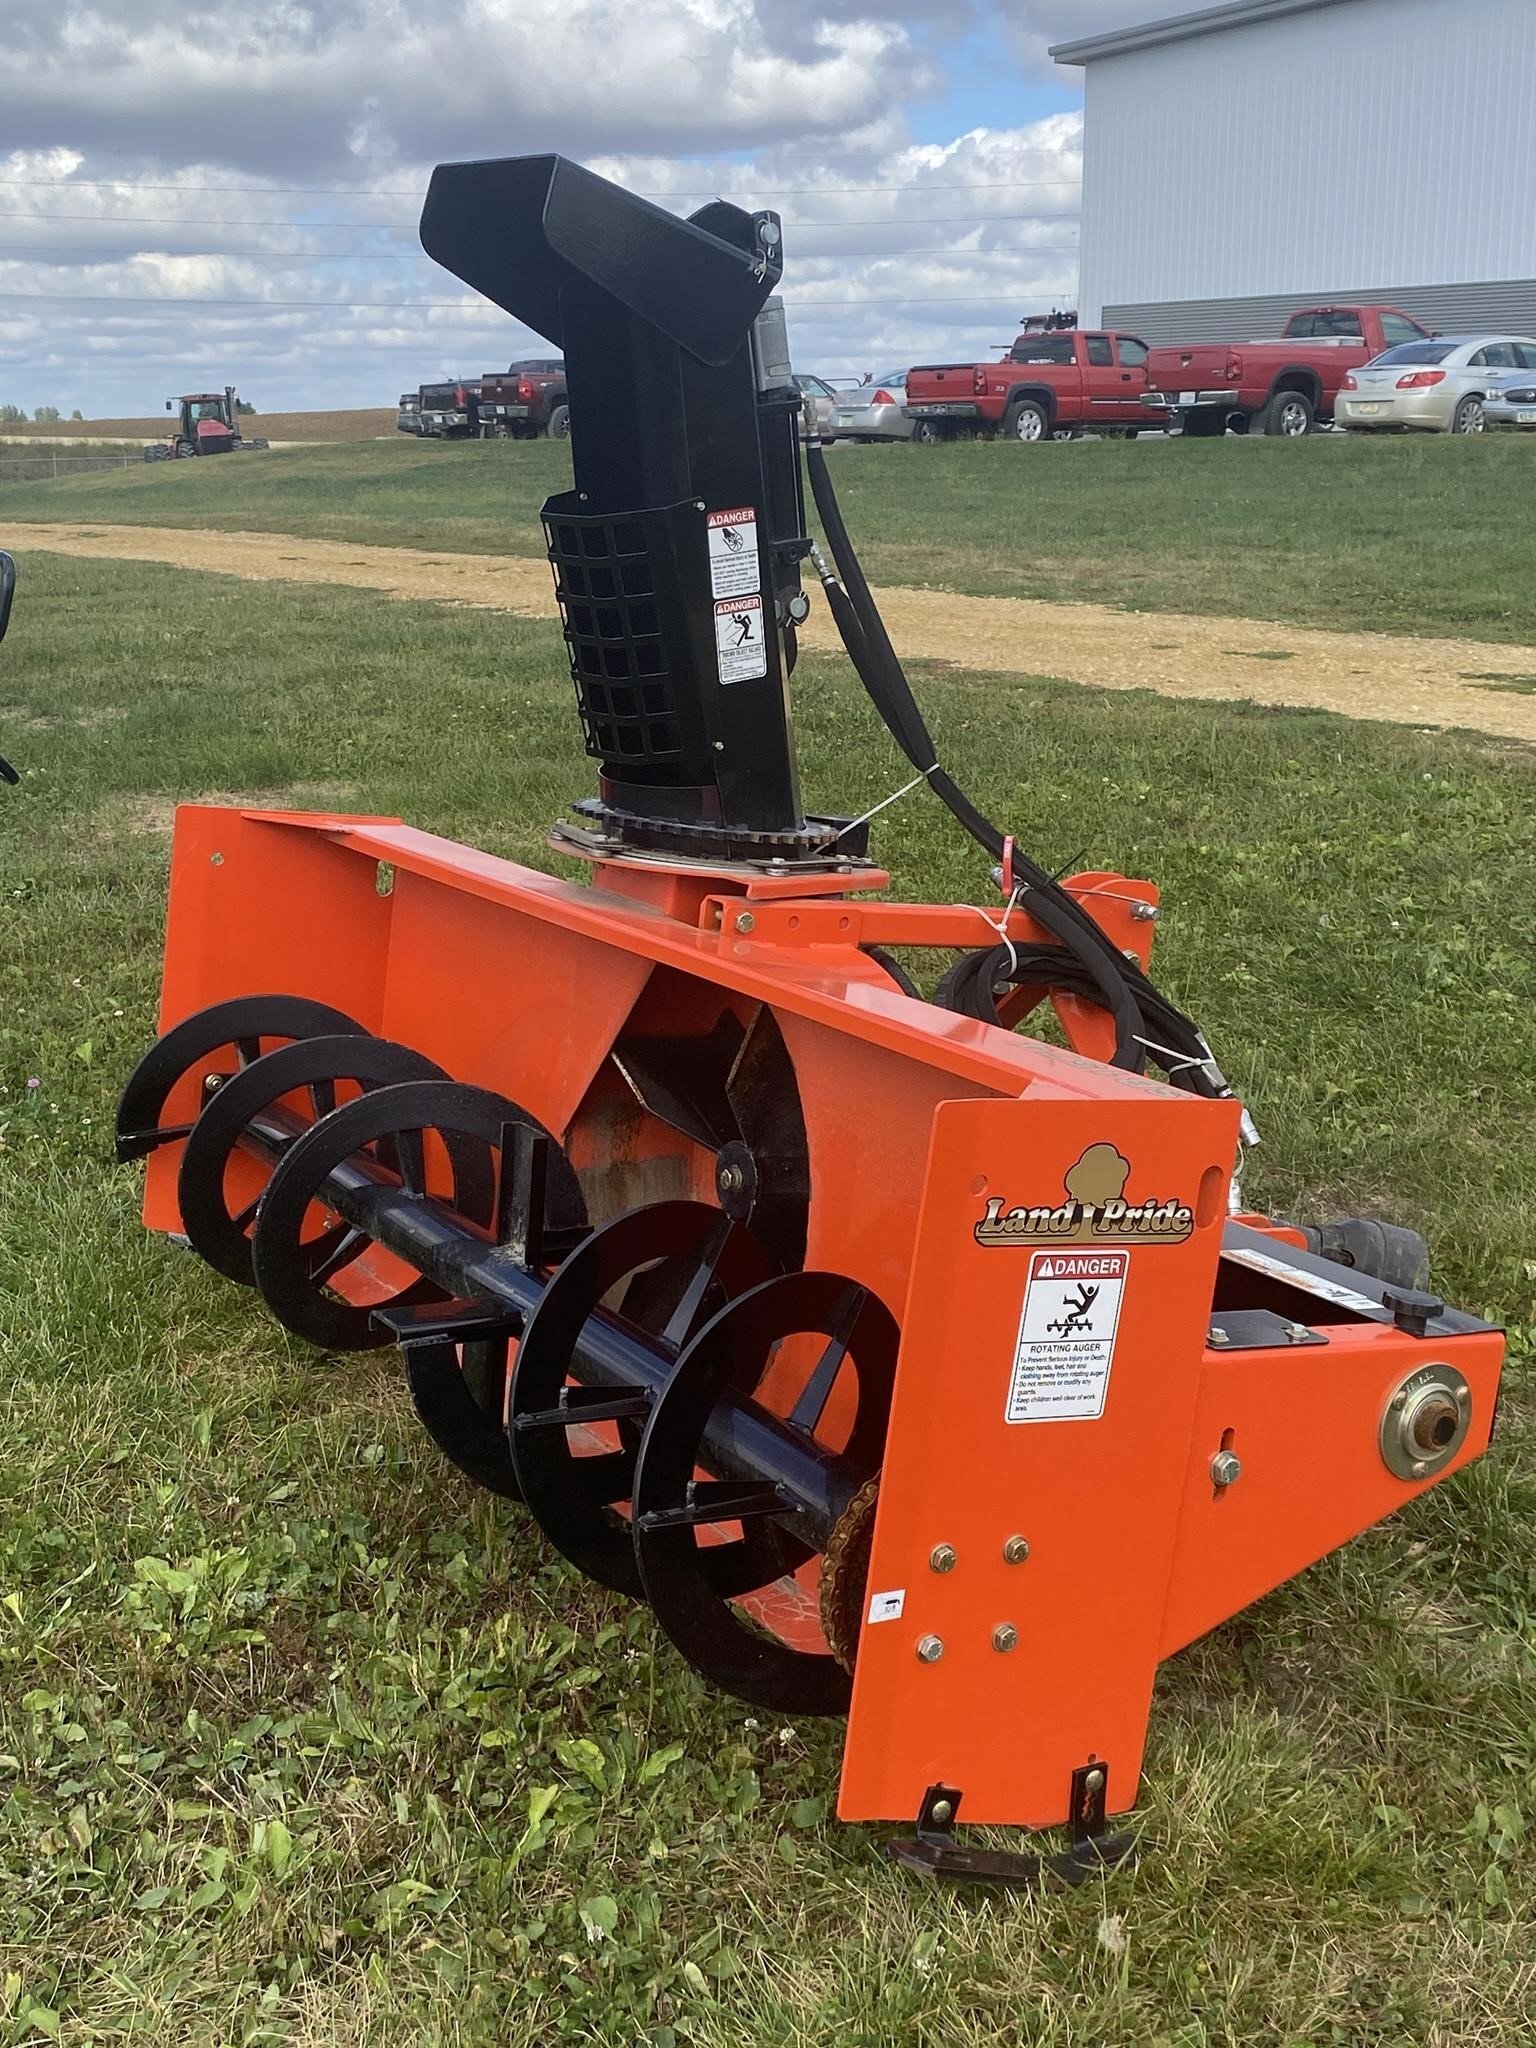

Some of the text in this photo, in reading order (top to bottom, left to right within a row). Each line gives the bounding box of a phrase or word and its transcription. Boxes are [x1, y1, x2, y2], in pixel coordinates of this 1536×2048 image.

[716, 510, 755, 525] DANGER
[723, 598, 760, 613] DANGER
[979, 1198, 1192, 1234] Land Pride
[1054, 1258, 1121, 1275] DANGER
[1030, 1343, 1101, 1354] ROTATING AUGER
[1020, 1372, 1041, 1380] clothing
